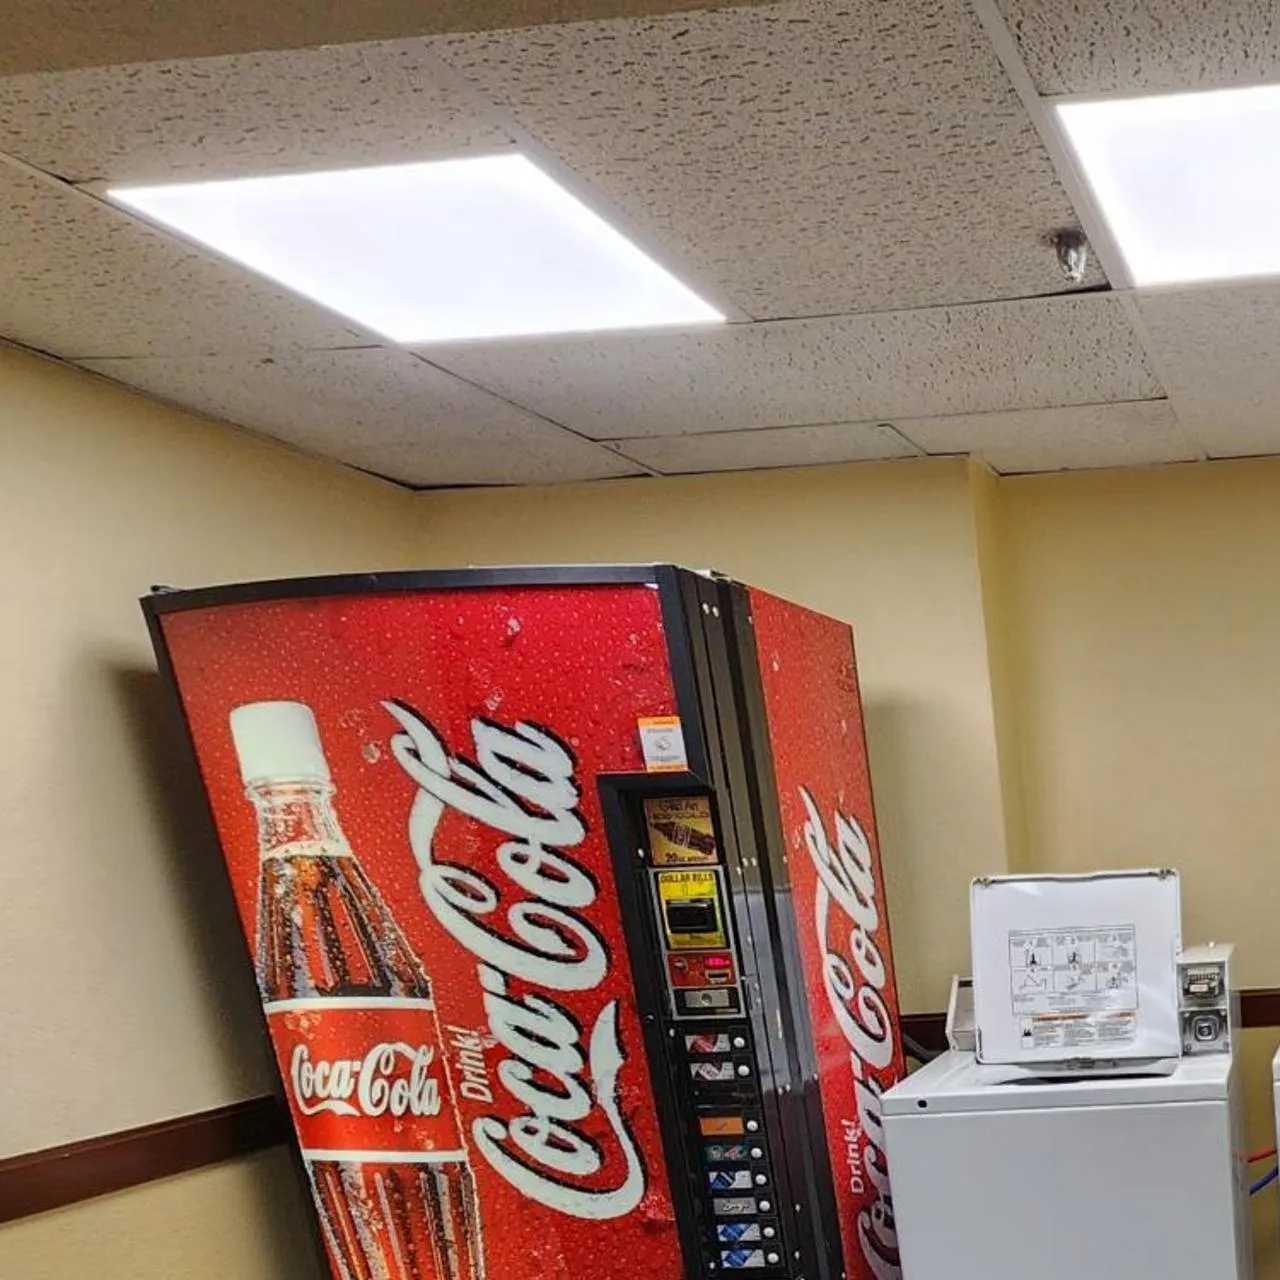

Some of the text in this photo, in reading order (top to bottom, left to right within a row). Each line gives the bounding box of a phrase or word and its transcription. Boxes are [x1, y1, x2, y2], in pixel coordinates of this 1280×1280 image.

[660, 872, 690, 884] DOLLAR
[381, 698, 646, 1221] Coca-Cola
[291, 1041, 441, 1117] Coca-Cola
[448, 1025, 493, 1104] Drink!
[840, 1119, 864, 1194] Drink!
